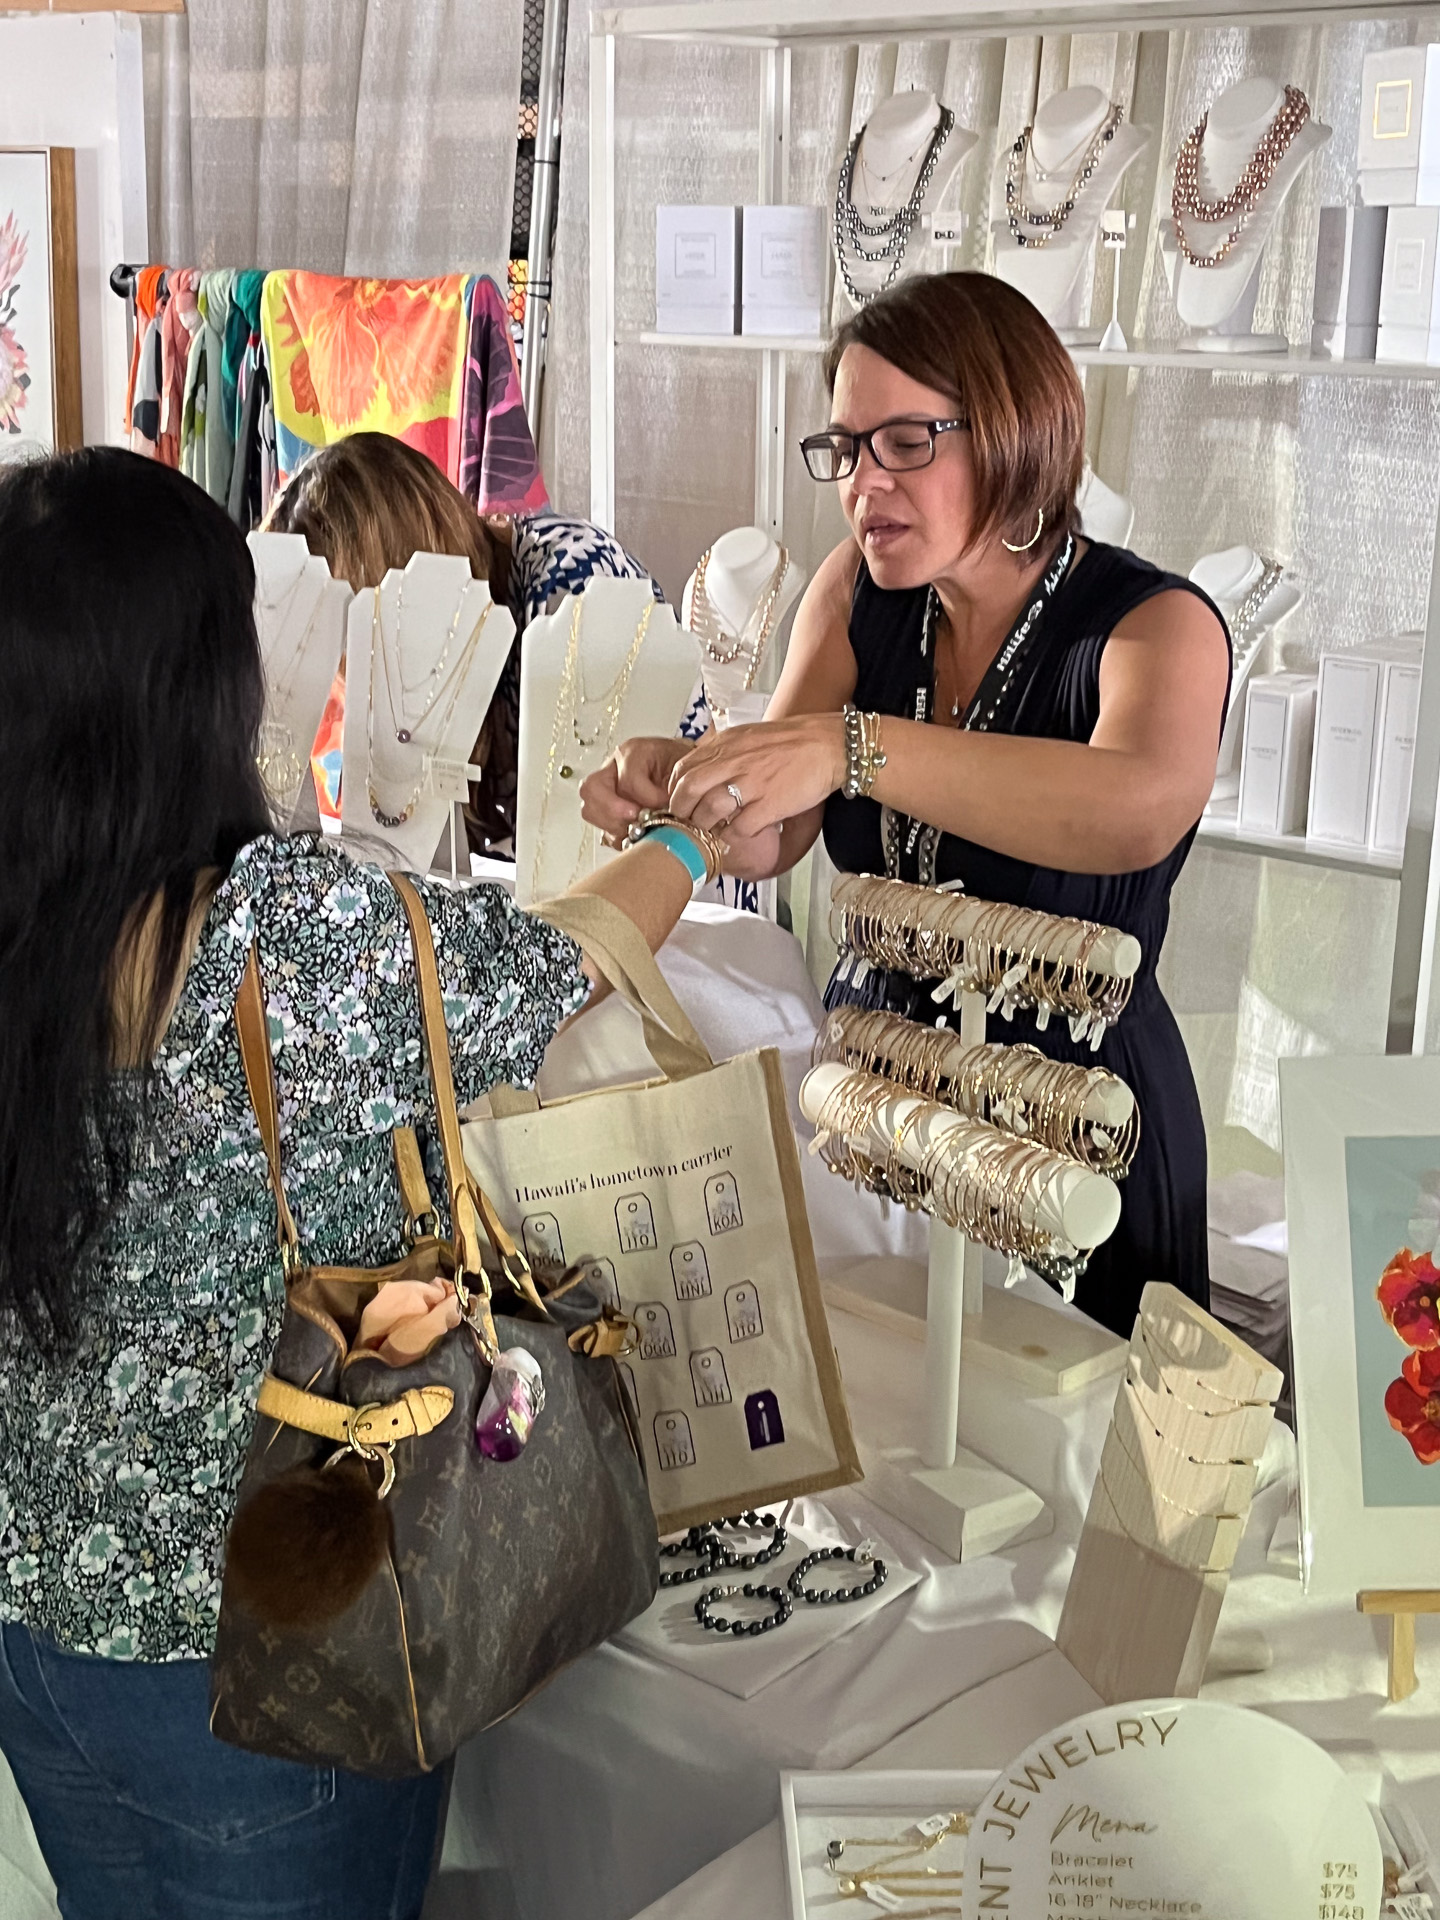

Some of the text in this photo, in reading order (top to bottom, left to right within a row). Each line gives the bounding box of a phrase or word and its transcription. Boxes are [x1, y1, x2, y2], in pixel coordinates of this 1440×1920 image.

[590, 1164, 678, 1190] hometown
[681, 1144, 734, 1172] carrier
[713, 1214, 740, 1232] KOA
[983, 1717, 1178, 1842] JEWELRY
[1051, 1851, 1134, 1869] Bracelet
[1048, 1871, 1114, 1888] Anklet
[1322, 1862, 1358, 1880] $75
[1109, 1894, 1202, 1914] Necklace
